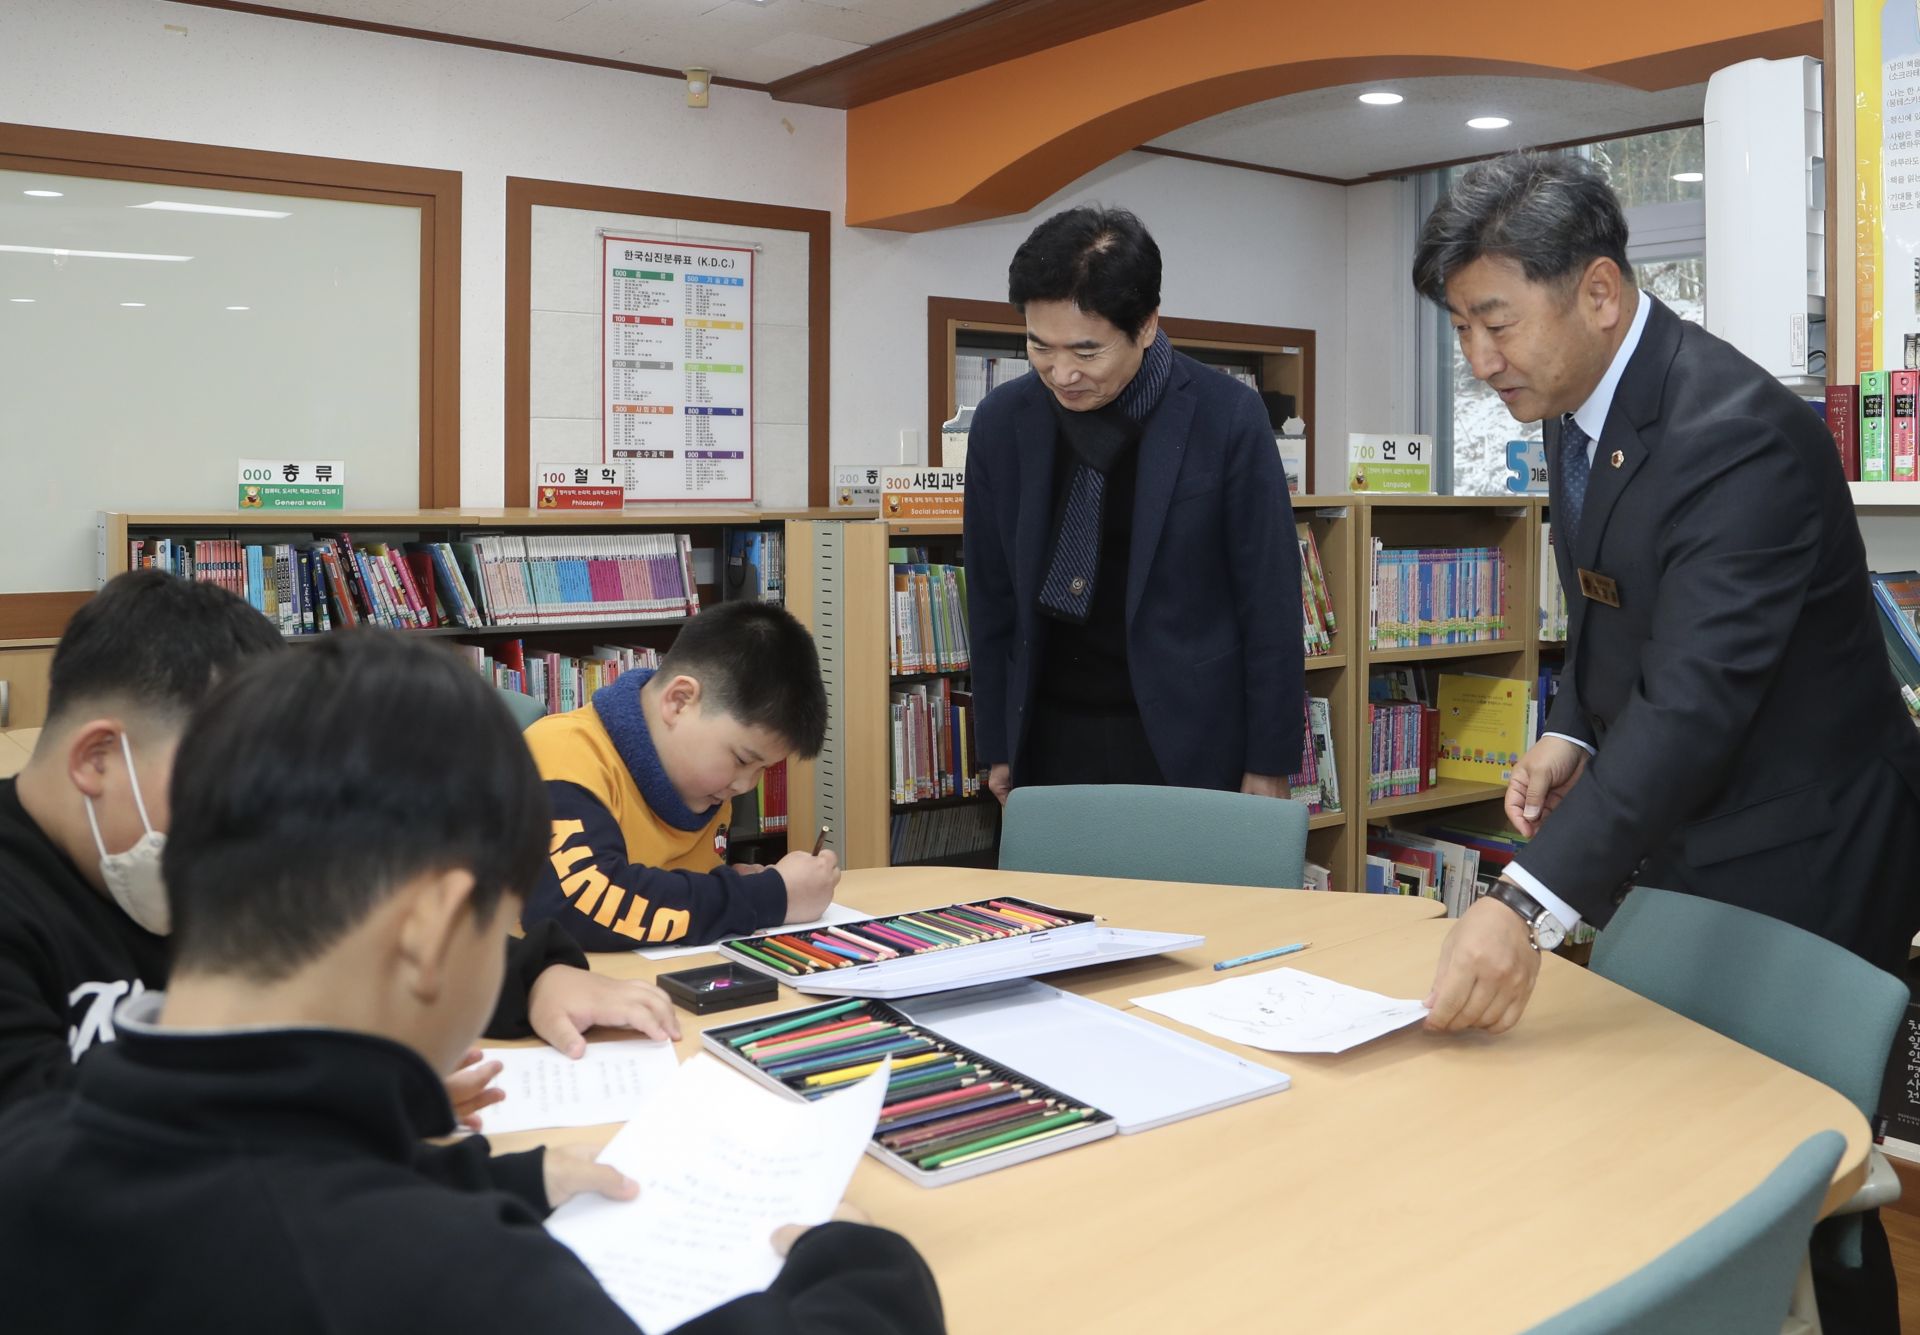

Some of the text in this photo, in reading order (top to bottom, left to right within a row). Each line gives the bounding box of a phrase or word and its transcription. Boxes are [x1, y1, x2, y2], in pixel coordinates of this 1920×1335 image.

[624, 250, 735, 268] 한국십진분류표 (K.D.C.)
[1353, 446, 1375, 459] 700
[243, 469, 272, 481] 000
[543, 472, 566, 483] 100
[840, 474, 859, 483] 200
[886, 477, 911, 490] 300
[572, 499, 604, 507] Philosophy
